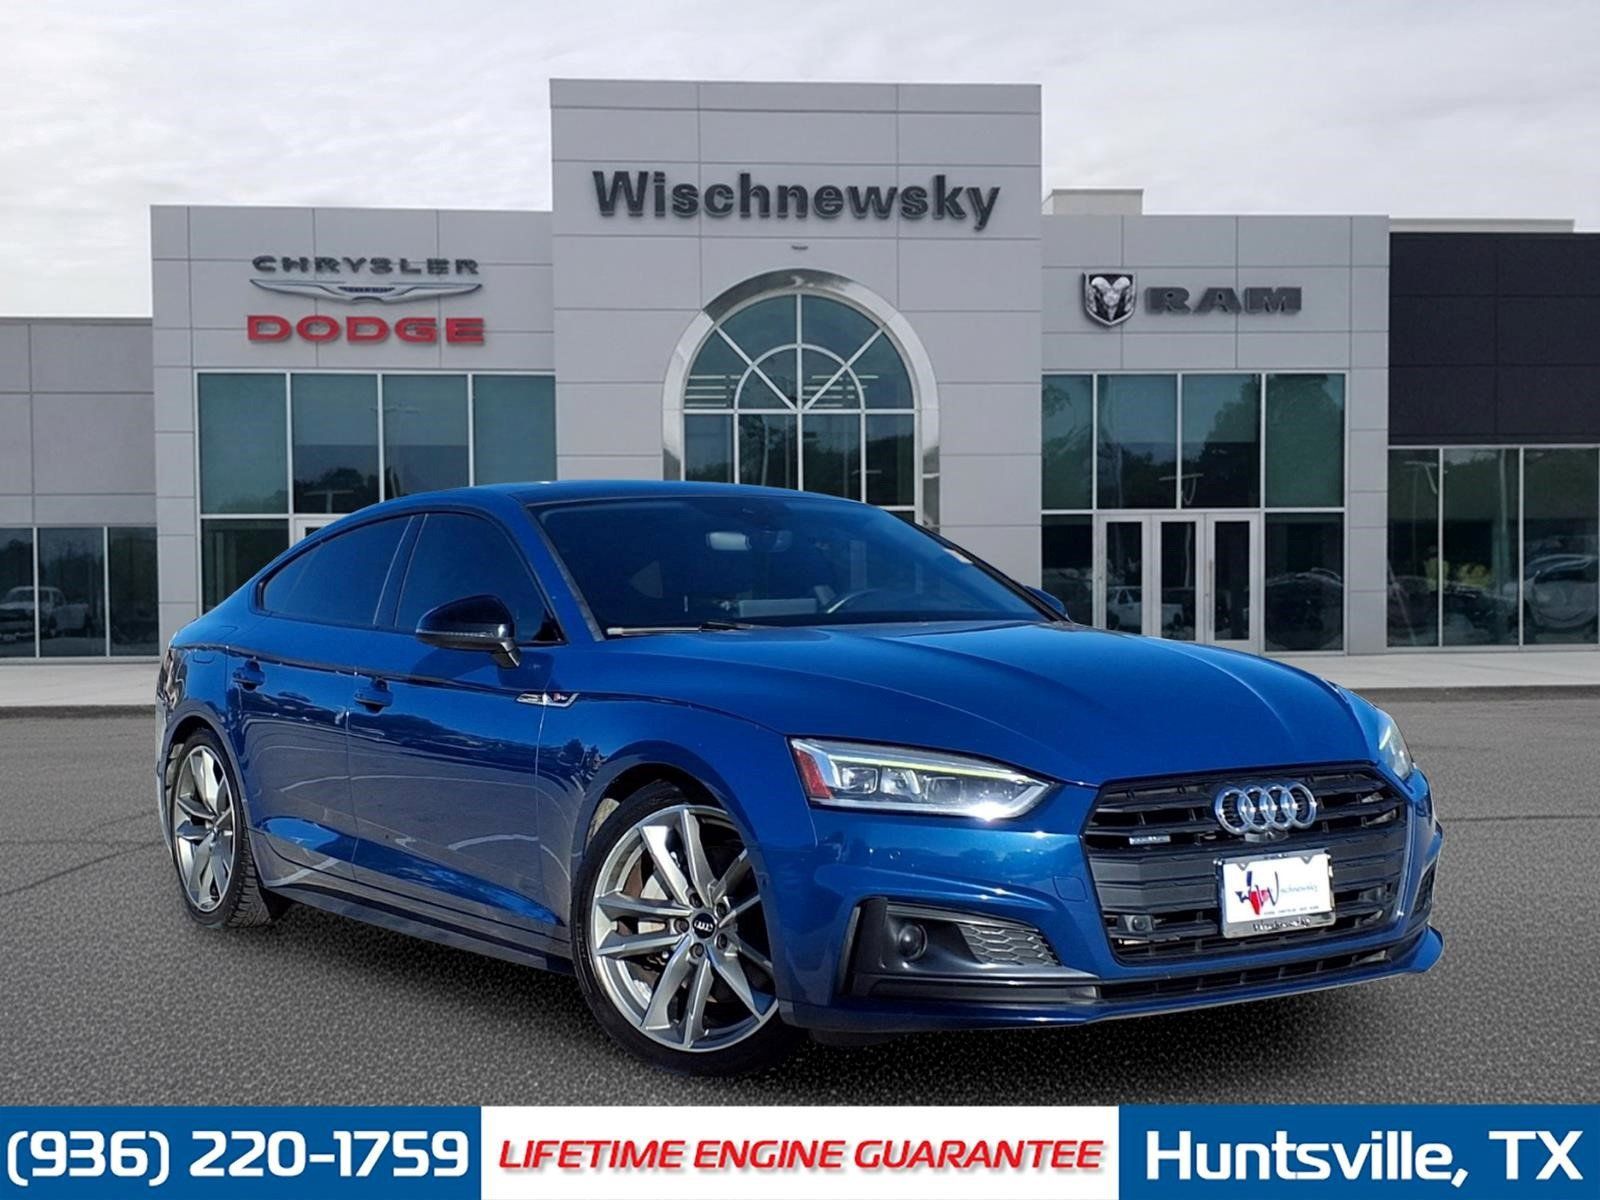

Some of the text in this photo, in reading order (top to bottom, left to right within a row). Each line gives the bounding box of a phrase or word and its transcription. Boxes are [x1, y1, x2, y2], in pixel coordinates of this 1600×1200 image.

[592, 170, 1001, 232] Wischnewsky
[252, 255, 479, 276] CHRYSLER
[1144, 286, 1302, 316] RAM
[247, 315, 484, 344] DODGE
